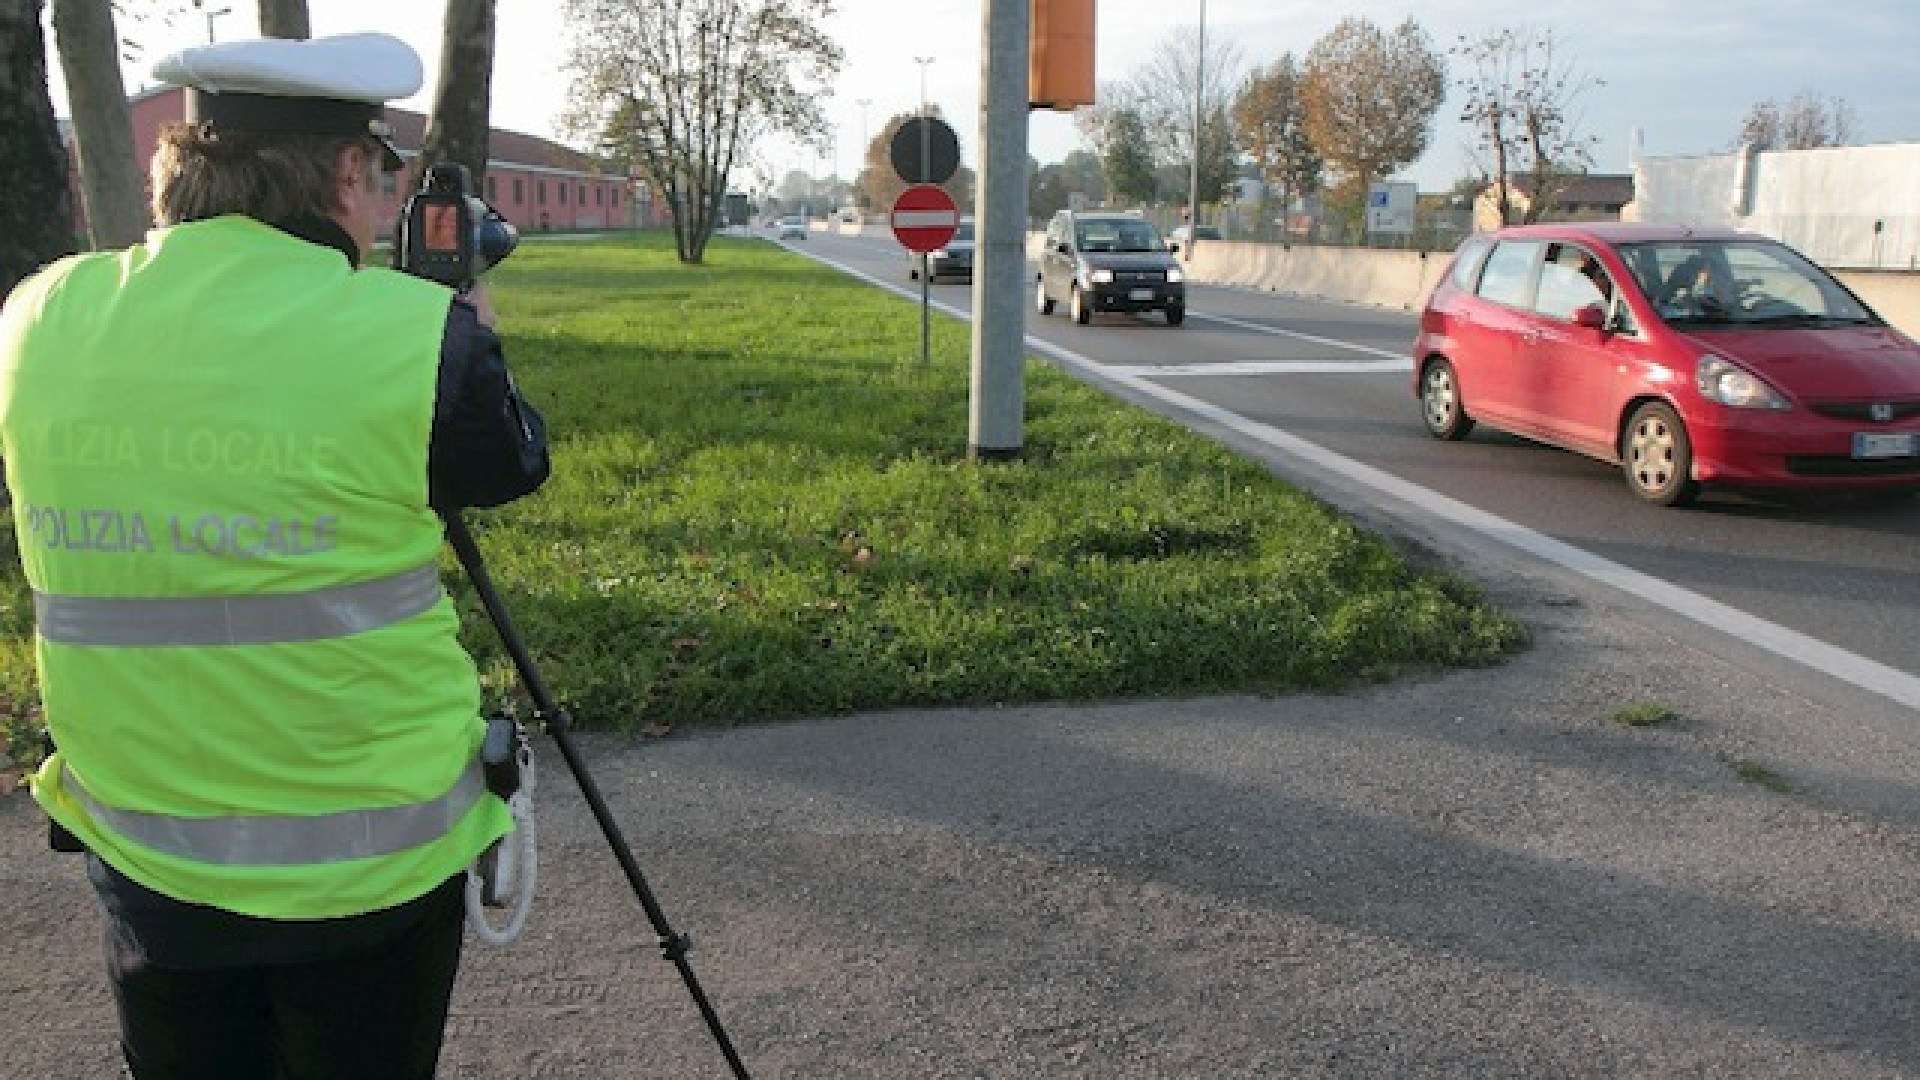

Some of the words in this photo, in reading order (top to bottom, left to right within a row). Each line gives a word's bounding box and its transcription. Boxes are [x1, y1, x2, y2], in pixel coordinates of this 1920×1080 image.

[162, 425, 338, 474] LOCALE
[27, 504, 155, 552] POLIZIA
[167, 514, 339, 557] LOCALE
